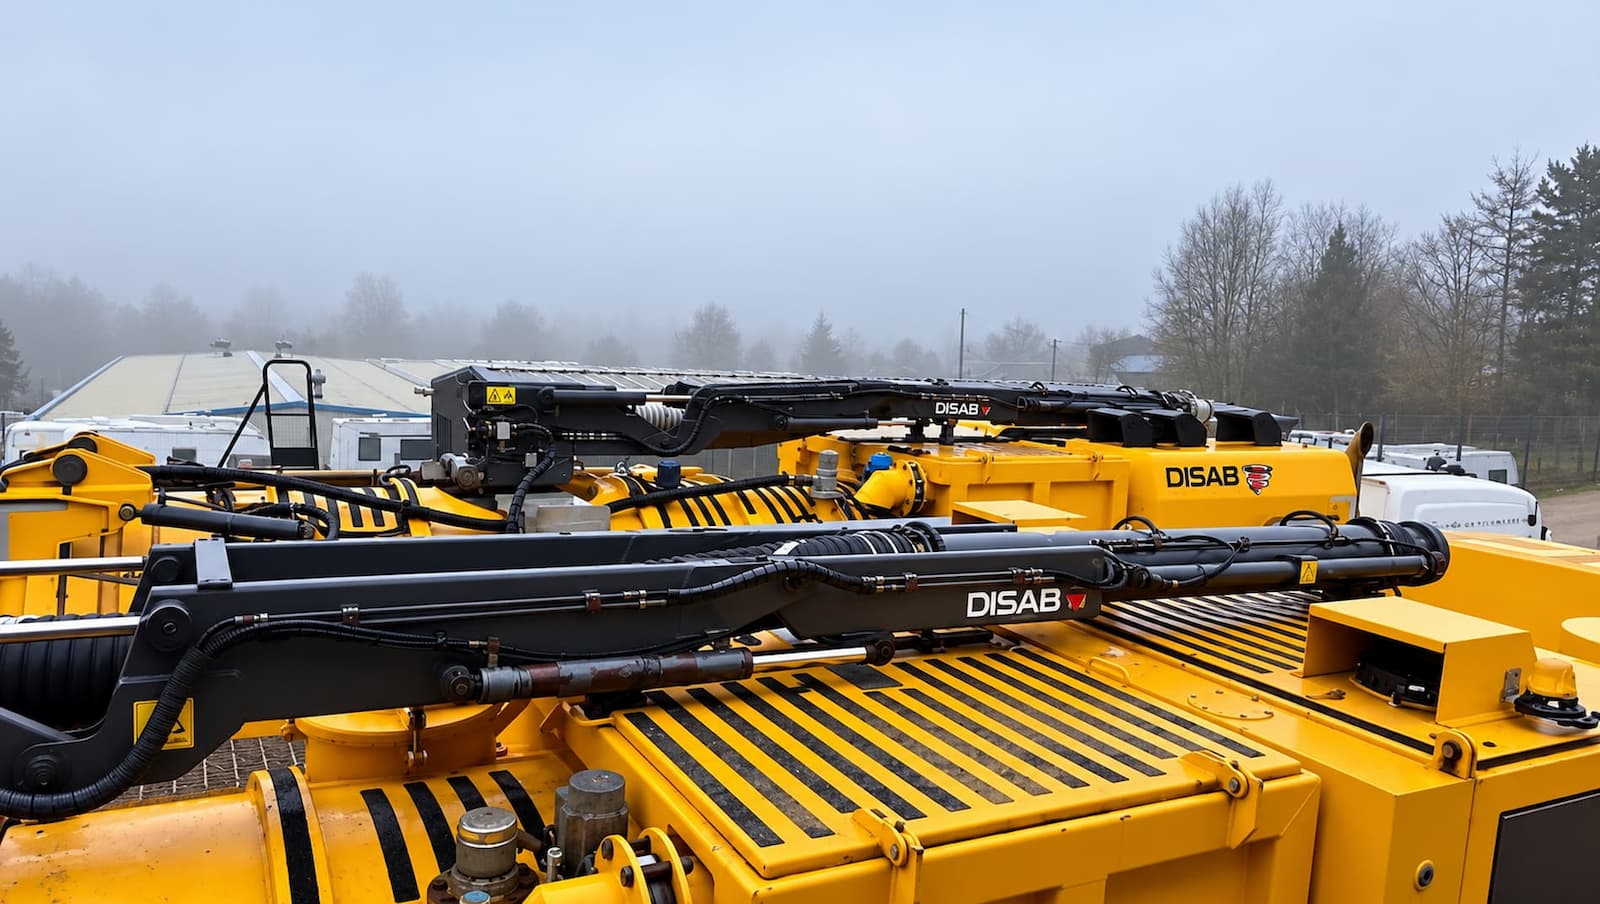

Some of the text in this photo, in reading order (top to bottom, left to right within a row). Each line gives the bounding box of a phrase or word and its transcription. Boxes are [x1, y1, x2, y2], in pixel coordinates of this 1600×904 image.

[935, 402, 979, 415] DISAB
[1165, 466, 1239, 488] DISAB
[966, 588, 1061, 618] DISAB
